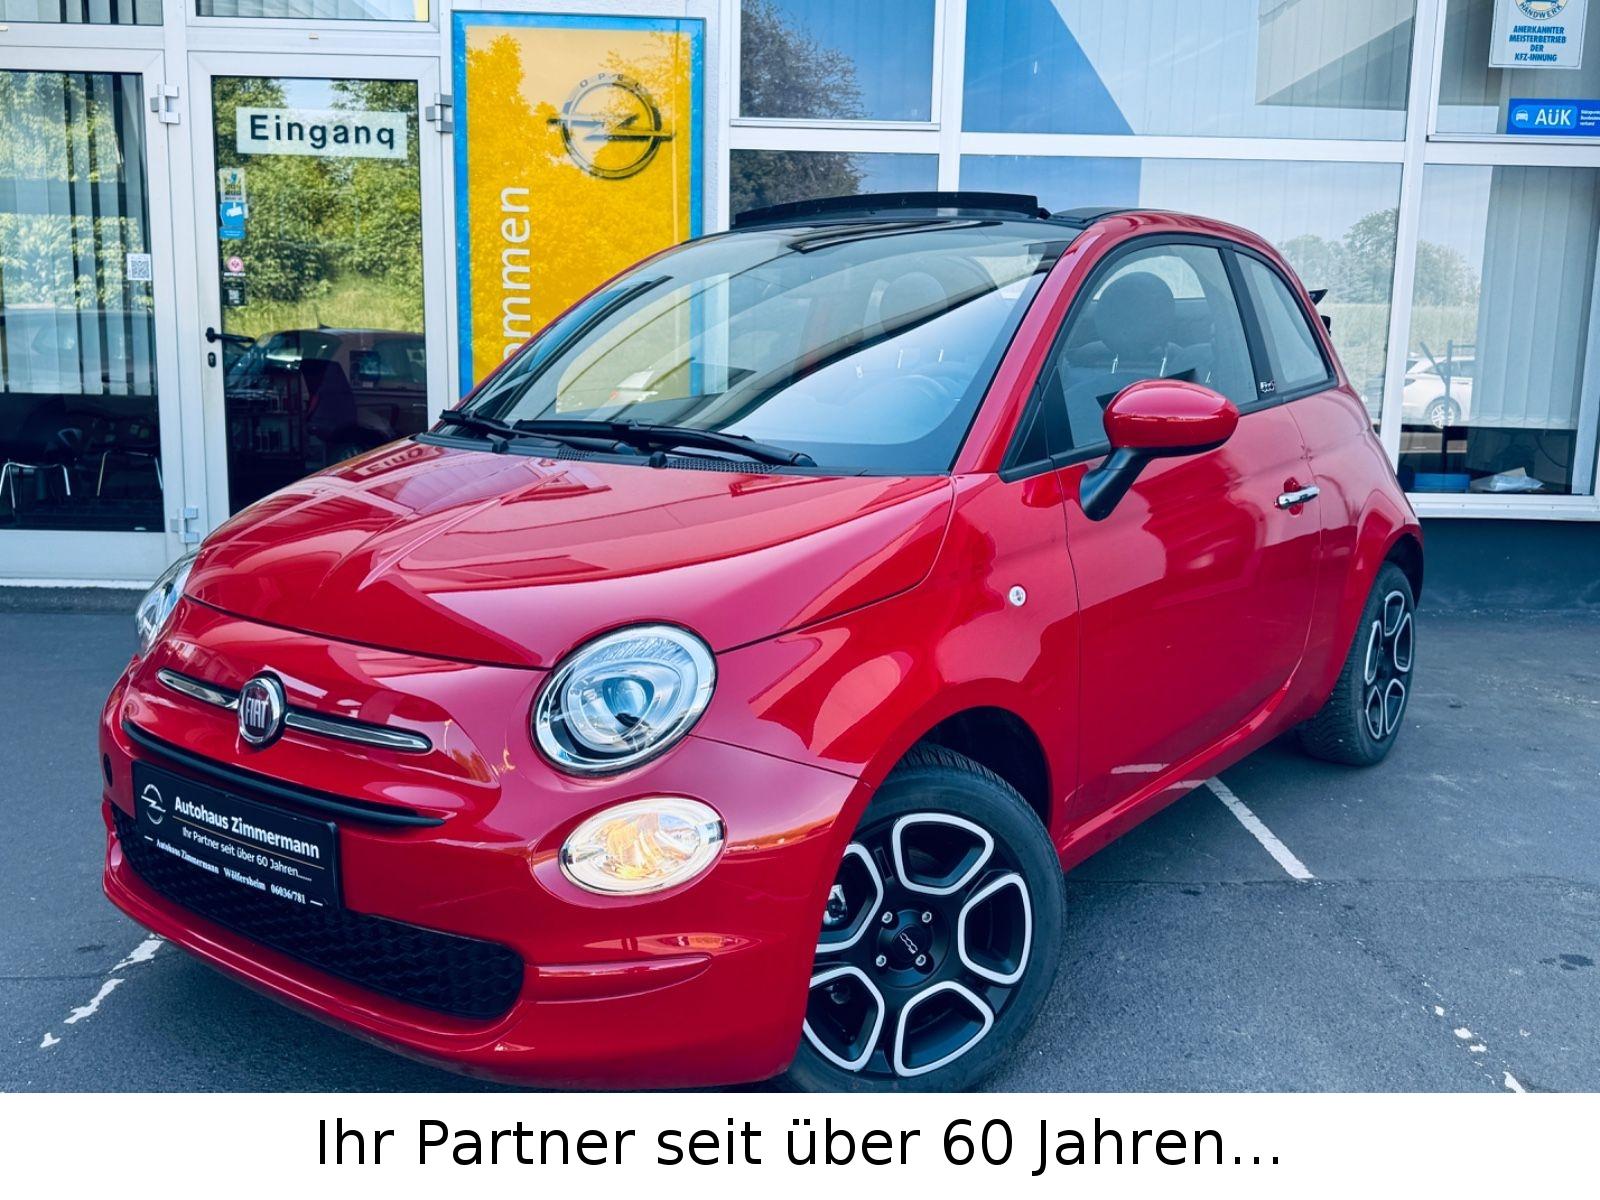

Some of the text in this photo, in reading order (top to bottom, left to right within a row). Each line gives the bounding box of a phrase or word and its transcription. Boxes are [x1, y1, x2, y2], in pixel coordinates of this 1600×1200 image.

[1513, 25, 1565, 34] ANERKANNTER
[1509, 35, 1567, 44] MEISTERBETRIEB
[1530, 44, 1544, 52] DER
[1514, 53, 1558, 62] KFZ-INNUNG
[245, 696, 269, 729] FIAT
[174, 796, 320, 860] Autohaus Zimmermann
[182, 826, 192, 840] Ihr
[193, 831, 220, 850] Partner
[220, 843, 236, 857] seit
[236, 847, 255, 864] über
[256, 854, 269, 868] 60
[181, 849, 220, 875] Zimmermann
